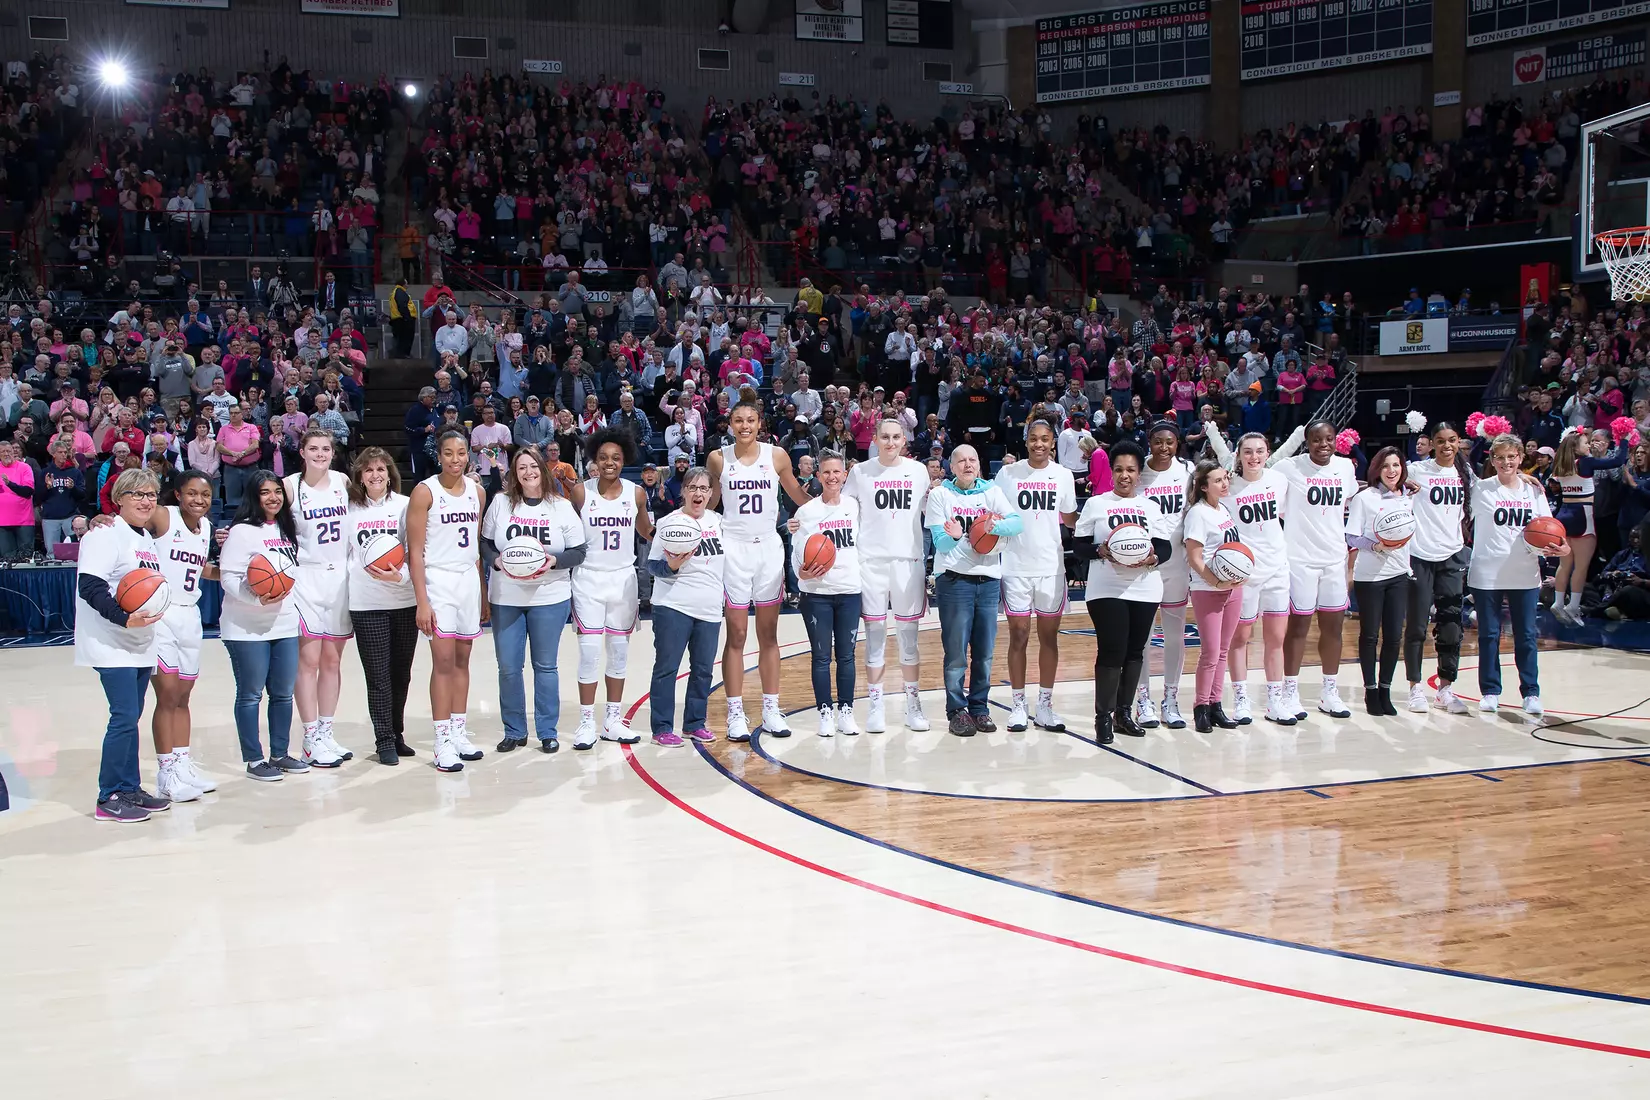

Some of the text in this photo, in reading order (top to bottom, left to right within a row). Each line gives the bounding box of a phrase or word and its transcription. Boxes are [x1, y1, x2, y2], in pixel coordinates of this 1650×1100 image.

[1040, 1, 1206, 30] BIG EAST CONFERENCE
[1325, 2, 1344, 16] 1999
[1040, 13, 1206, 40] REGULAR SEASON CHAMPIONS
[1188, 23, 1208, 37] 2002
[1473, 23, 1553, 44] CONNECTICUT
[1559, 14, 1595, 27] MEN'S
[1113, 33, 1131, 46] 1996
[1163, 27, 1182, 40] 1999
[1063, 39, 1081, 52] 1994
[1088, 36, 1106, 49] 1995
[1244, 33, 1264, 48] 2016
[1578, 35, 1614, 51] 1988
[541, 62, 561, 71] 210
[1039, 60, 1058, 73] 2003
[1063, 57, 1083, 70] 2005
[1247, 46, 1426, 78] CONNECTICUT MEN'S BASKETBALL
[1520, 60, 1540, 74] NIT
[799, 75, 814, 84] 211
[956, 84, 972, 92] 212
[1042, 77, 1206, 101] CONNECTICUT MEN'S BASKETBALL
[588, 292, 609, 301] 210
[1451, 328, 1517, 339] @UCONNHUSKIES
[1416, 344, 1431, 352] ROTC
[728, 479, 771, 490] UCONN
[874, 481, 913, 489] POWER OF
[1017, 482, 1057, 490] POWER OF
[1307, 478, 1332, 486] POWER
[1429, 478, 1456, 486] POWER
[1144, 485, 1182, 496] POWER OF
[1307, 486, 1343, 506] ONE
[1429, 486, 1464, 506] ONE
[738, 494, 763, 514] 20
[875, 489, 913, 510] ONE
[1017, 490, 1057, 511] ONE
[1236, 492, 1275, 505] POWER OF
[1495, 500, 1522, 508] POWER
[303, 506, 347, 521] UCONN
[440, 512, 479, 524] UCONN
[1107, 507, 1136, 516] POWER
[1239, 500, 1277, 524] ONE
[1384, 511, 1410, 524] UCONN
[1494, 508, 1533, 527] ONE
[357, 520, 398, 530] POWER OF
[509, 515, 538, 526] POWER
[589, 517, 632, 527] UCONN
[818, 520, 845, 531] POWER
[316, 520, 341, 545] 25
[458, 527, 470, 548] 3
[602, 530, 621, 551] 13
[1121, 543, 1147, 551] UCONN
[183, 568, 198, 592] 5
